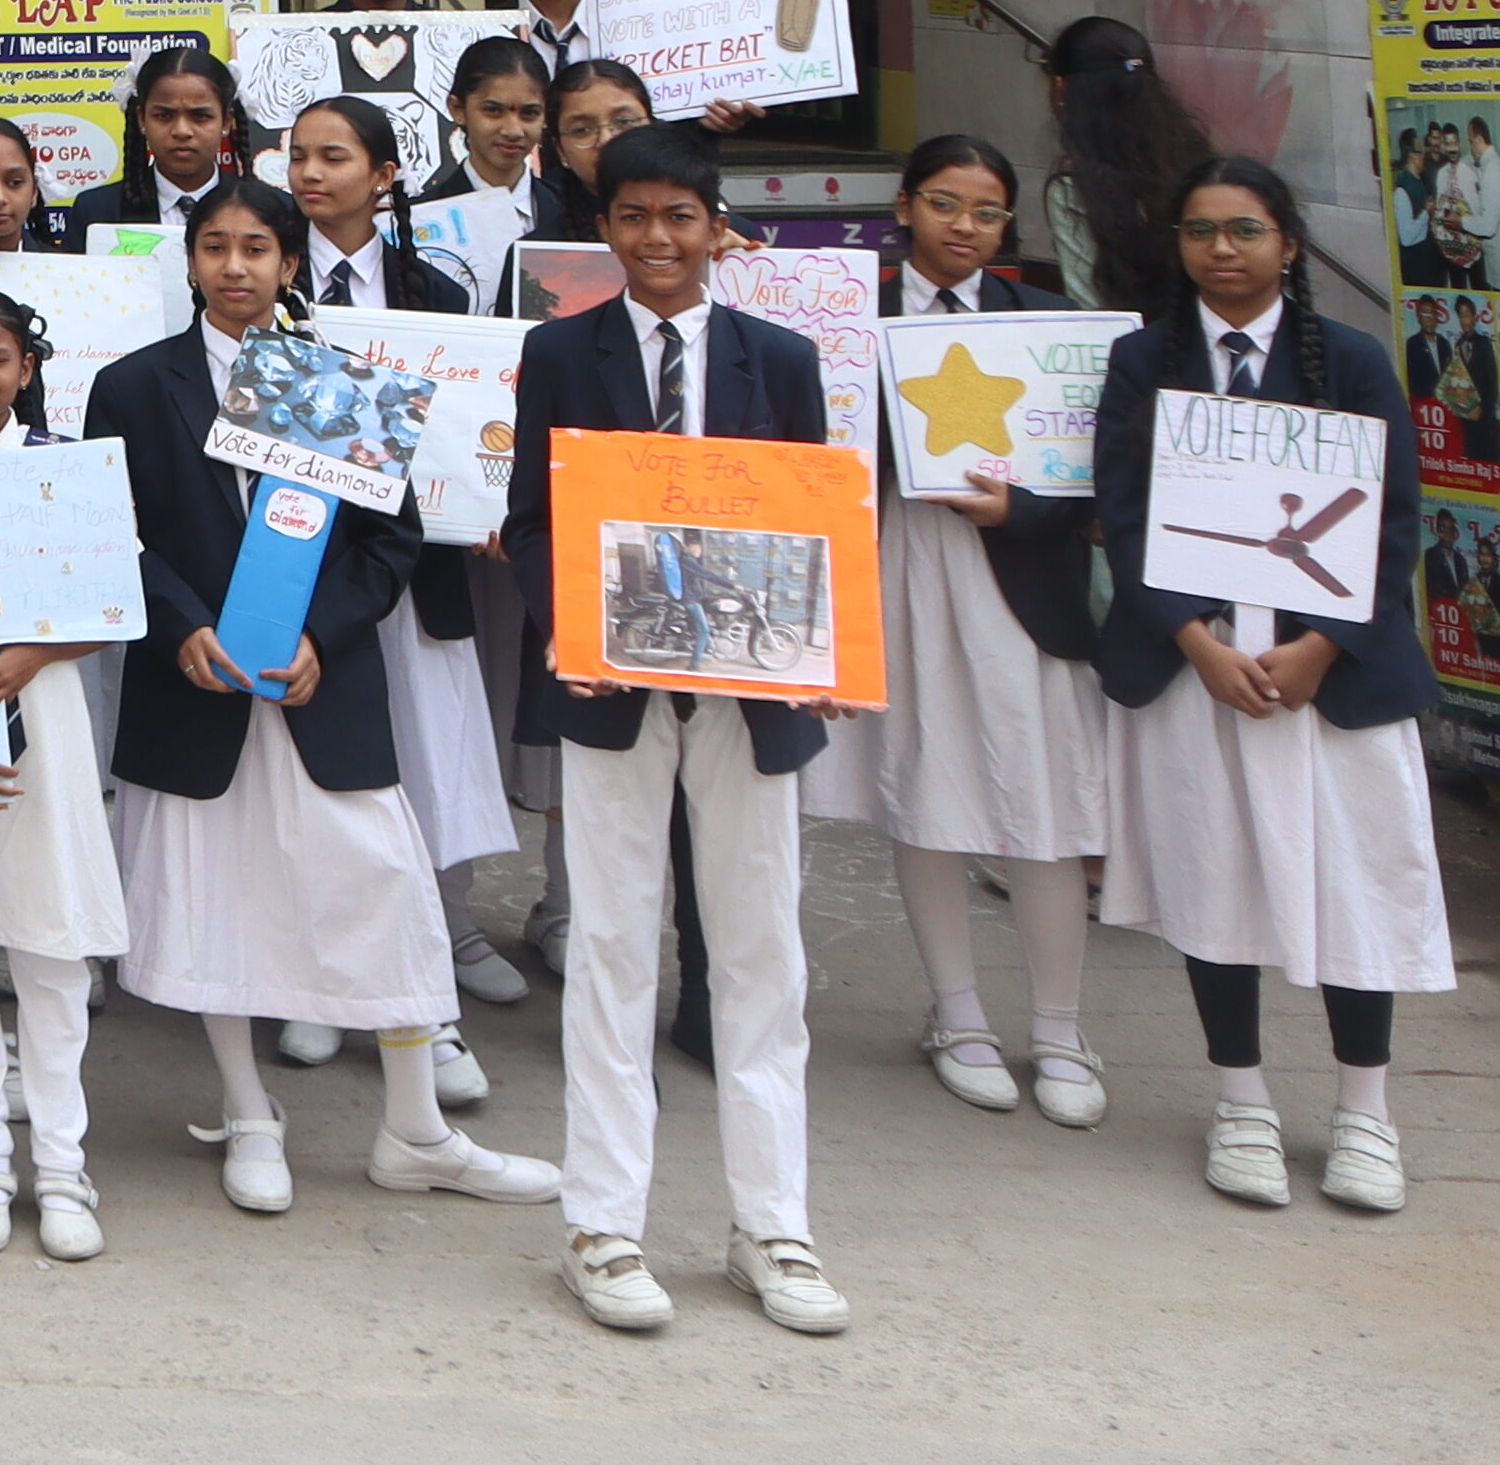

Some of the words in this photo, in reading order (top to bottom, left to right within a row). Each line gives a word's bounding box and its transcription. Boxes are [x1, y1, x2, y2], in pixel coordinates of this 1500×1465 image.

[600, 13, 654, 44] VOTE
[663, 1, 731, 33] WITH
[22, 35, 93, 55] Medical
[59, 147, 91, 161] GPA
[421, 344, 480, 379] Love
[1026, 344, 1108, 373] VOTE
[1157, 396, 1246, 461] VOTE
[1250, 404, 1308, 470] FOR
[1316, 411, 1382, 482] FAN
[212, 426, 256, 457] Vote
[263, 444, 295, 469] for
[302, 456, 393, 500] diamond
[625, 441, 689, 476] VOTE
[660, 480, 759, 515] BULLET
